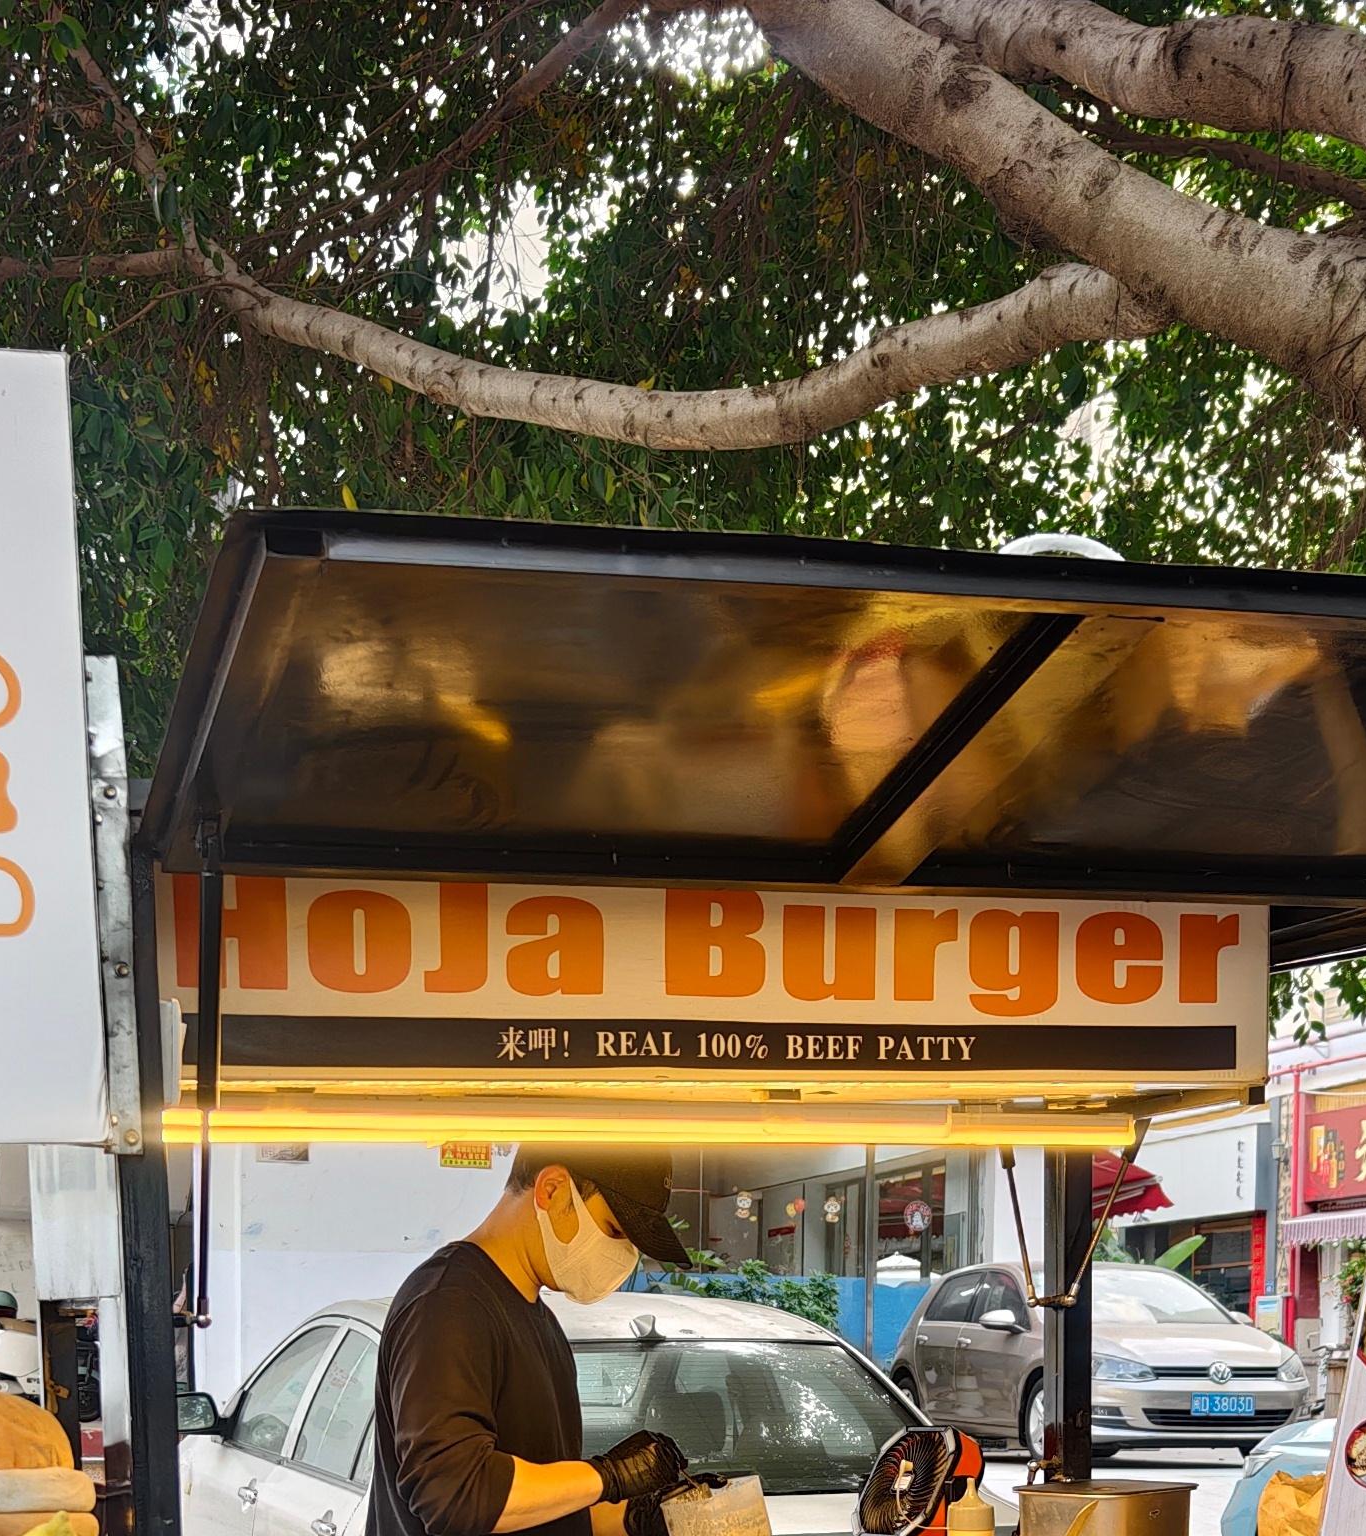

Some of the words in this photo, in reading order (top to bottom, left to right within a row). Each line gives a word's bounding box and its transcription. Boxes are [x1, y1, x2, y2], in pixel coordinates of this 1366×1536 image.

[664, 887, 1239, 1017] Burger
[595, 1030, 681, 1058] REAL
[696, 1032, 769, 1060] 100%
[785, 1034, 863, 1061] BEEF
[876, 1035, 977, 1062] PATTY
